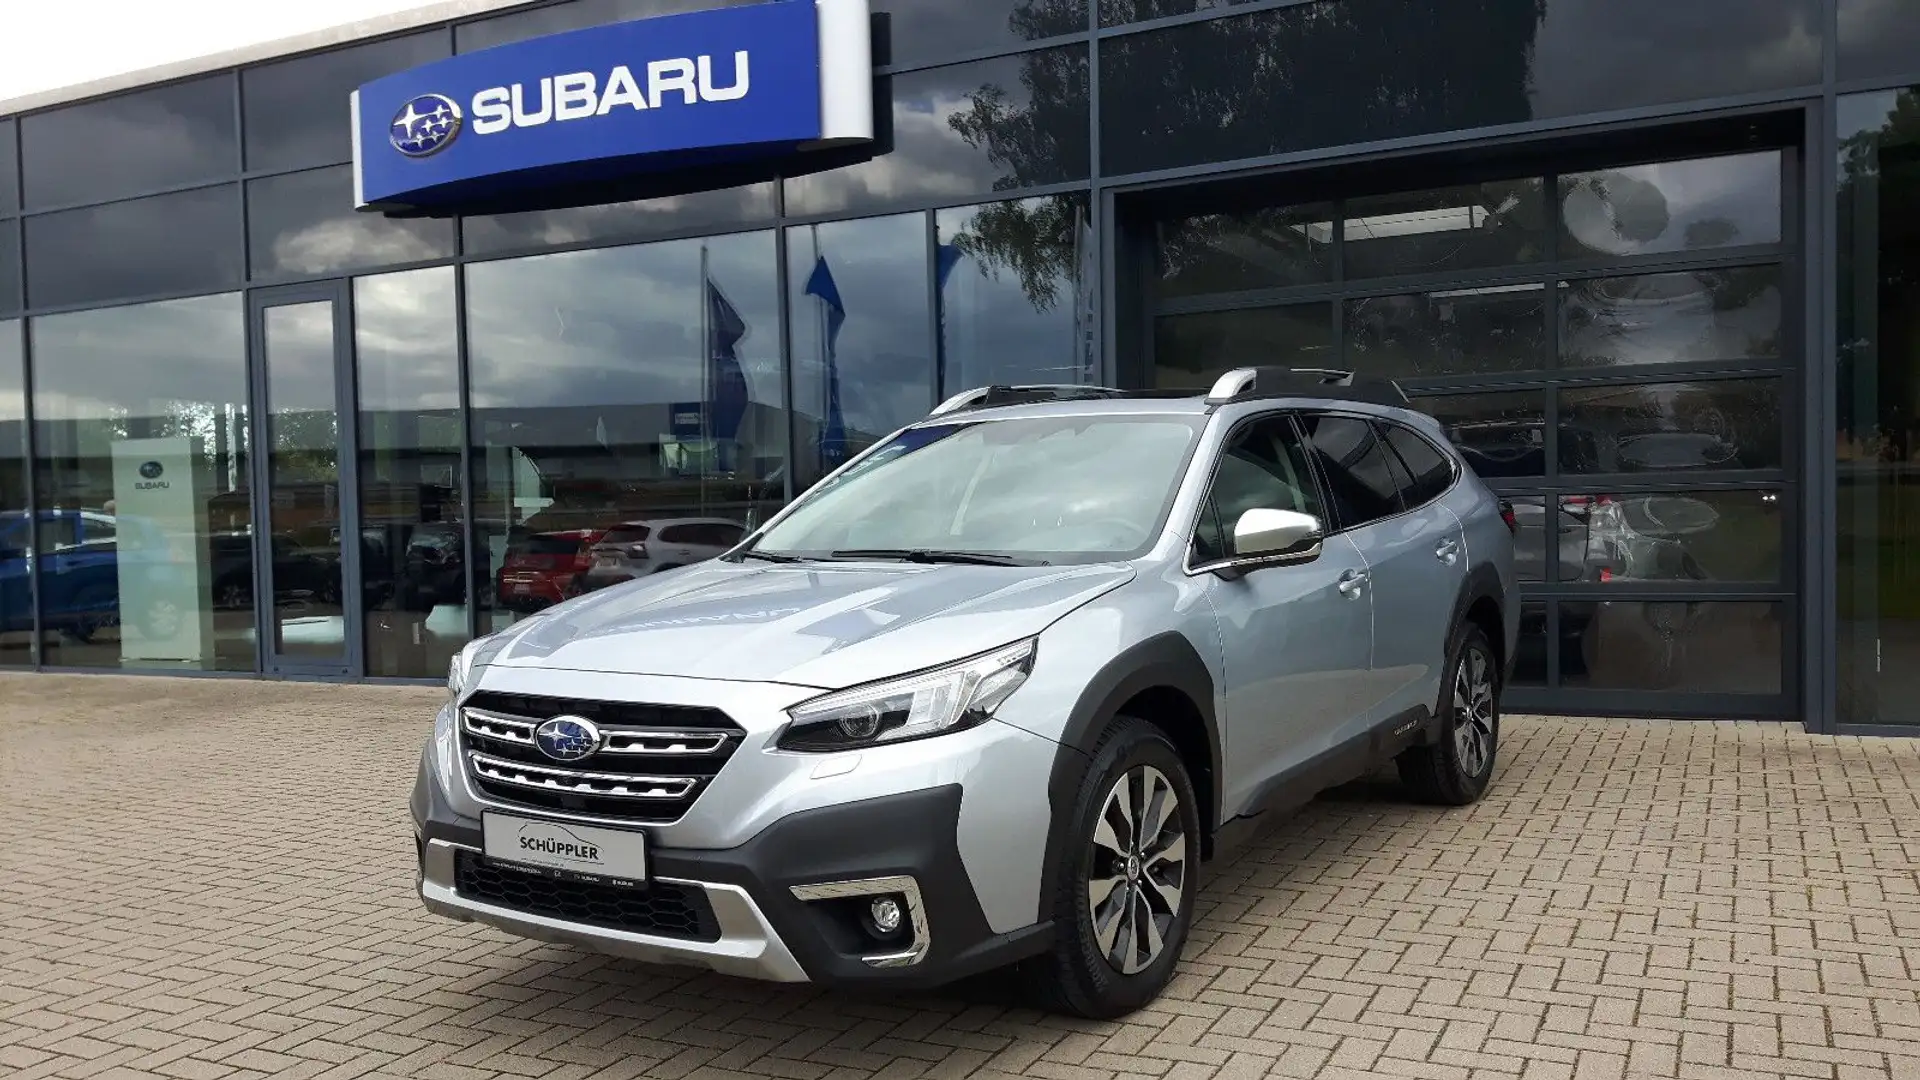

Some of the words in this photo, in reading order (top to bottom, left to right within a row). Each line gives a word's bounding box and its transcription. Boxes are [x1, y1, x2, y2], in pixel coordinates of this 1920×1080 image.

[471, 50, 749, 135] SUBARU
[134, 482, 170, 490] SUBARU
[519, 836, 599, 860] SCHÜPPLER
